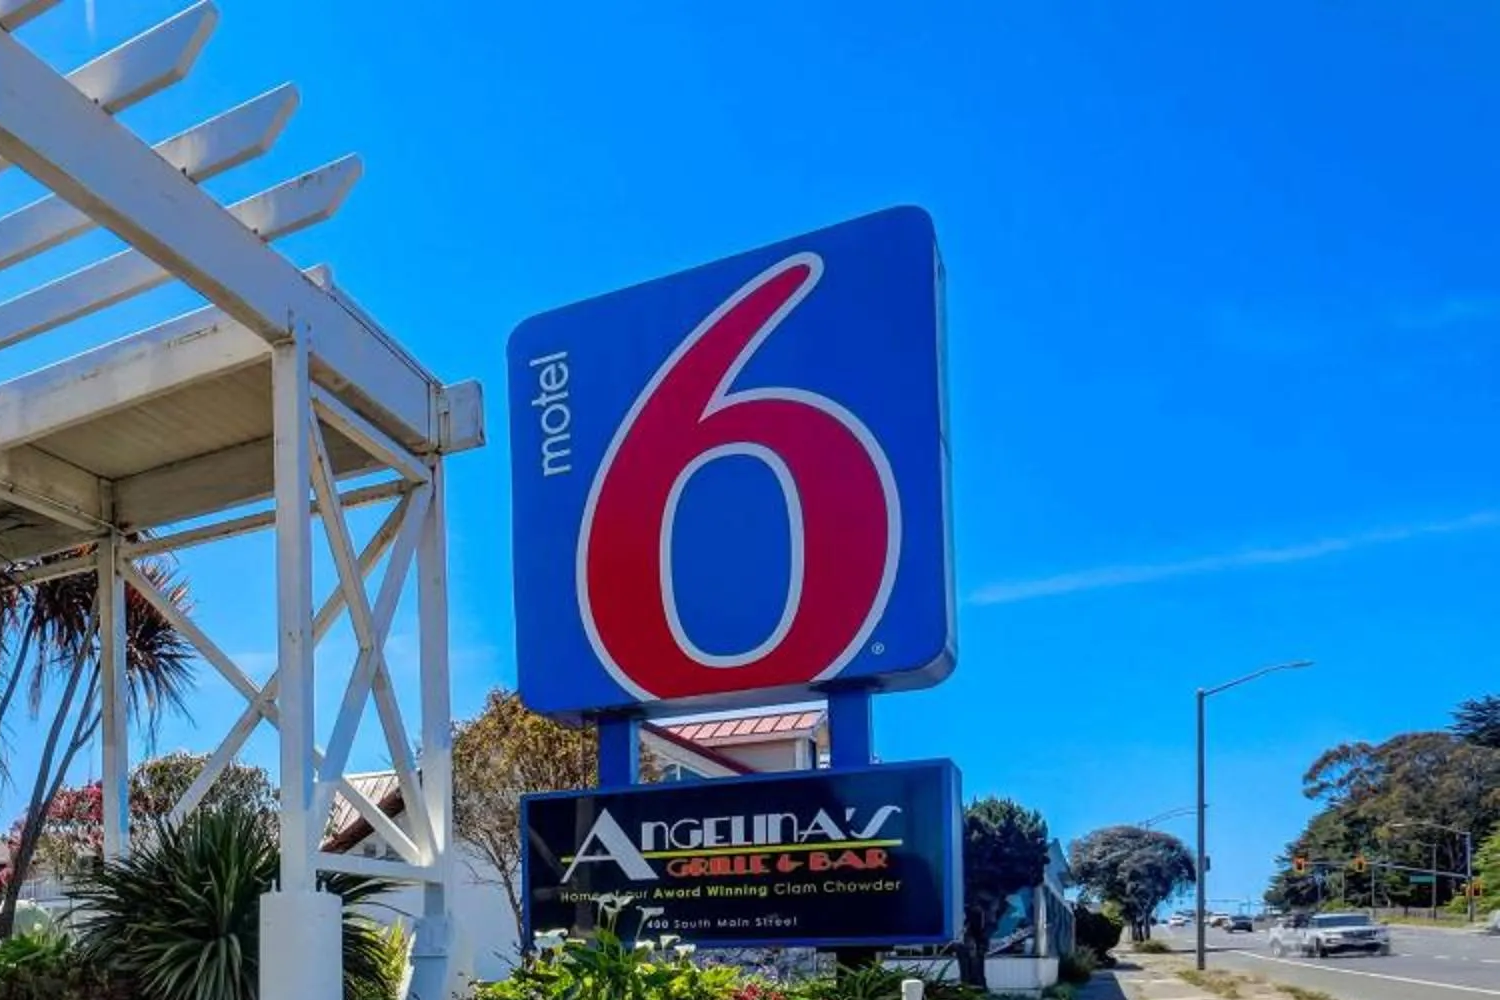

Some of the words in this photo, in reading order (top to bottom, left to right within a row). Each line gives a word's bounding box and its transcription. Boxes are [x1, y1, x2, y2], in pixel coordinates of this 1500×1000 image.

[529, 351, 572, 477] motel
[576, 250, 902, 702] 6
[776, 853, 804, 873] &
[809, 848, 888, 872] BAR
[653, 886, 701, 900] Award
[706, 883, 769, 898] Winning
[773, 882, 817, 895] Clam
[823, 879, 902, 893] Chowder
[673, 918, 711, 929] South
[717, 918, 749, 928] Main
[755, 916, 797, 927] Street
